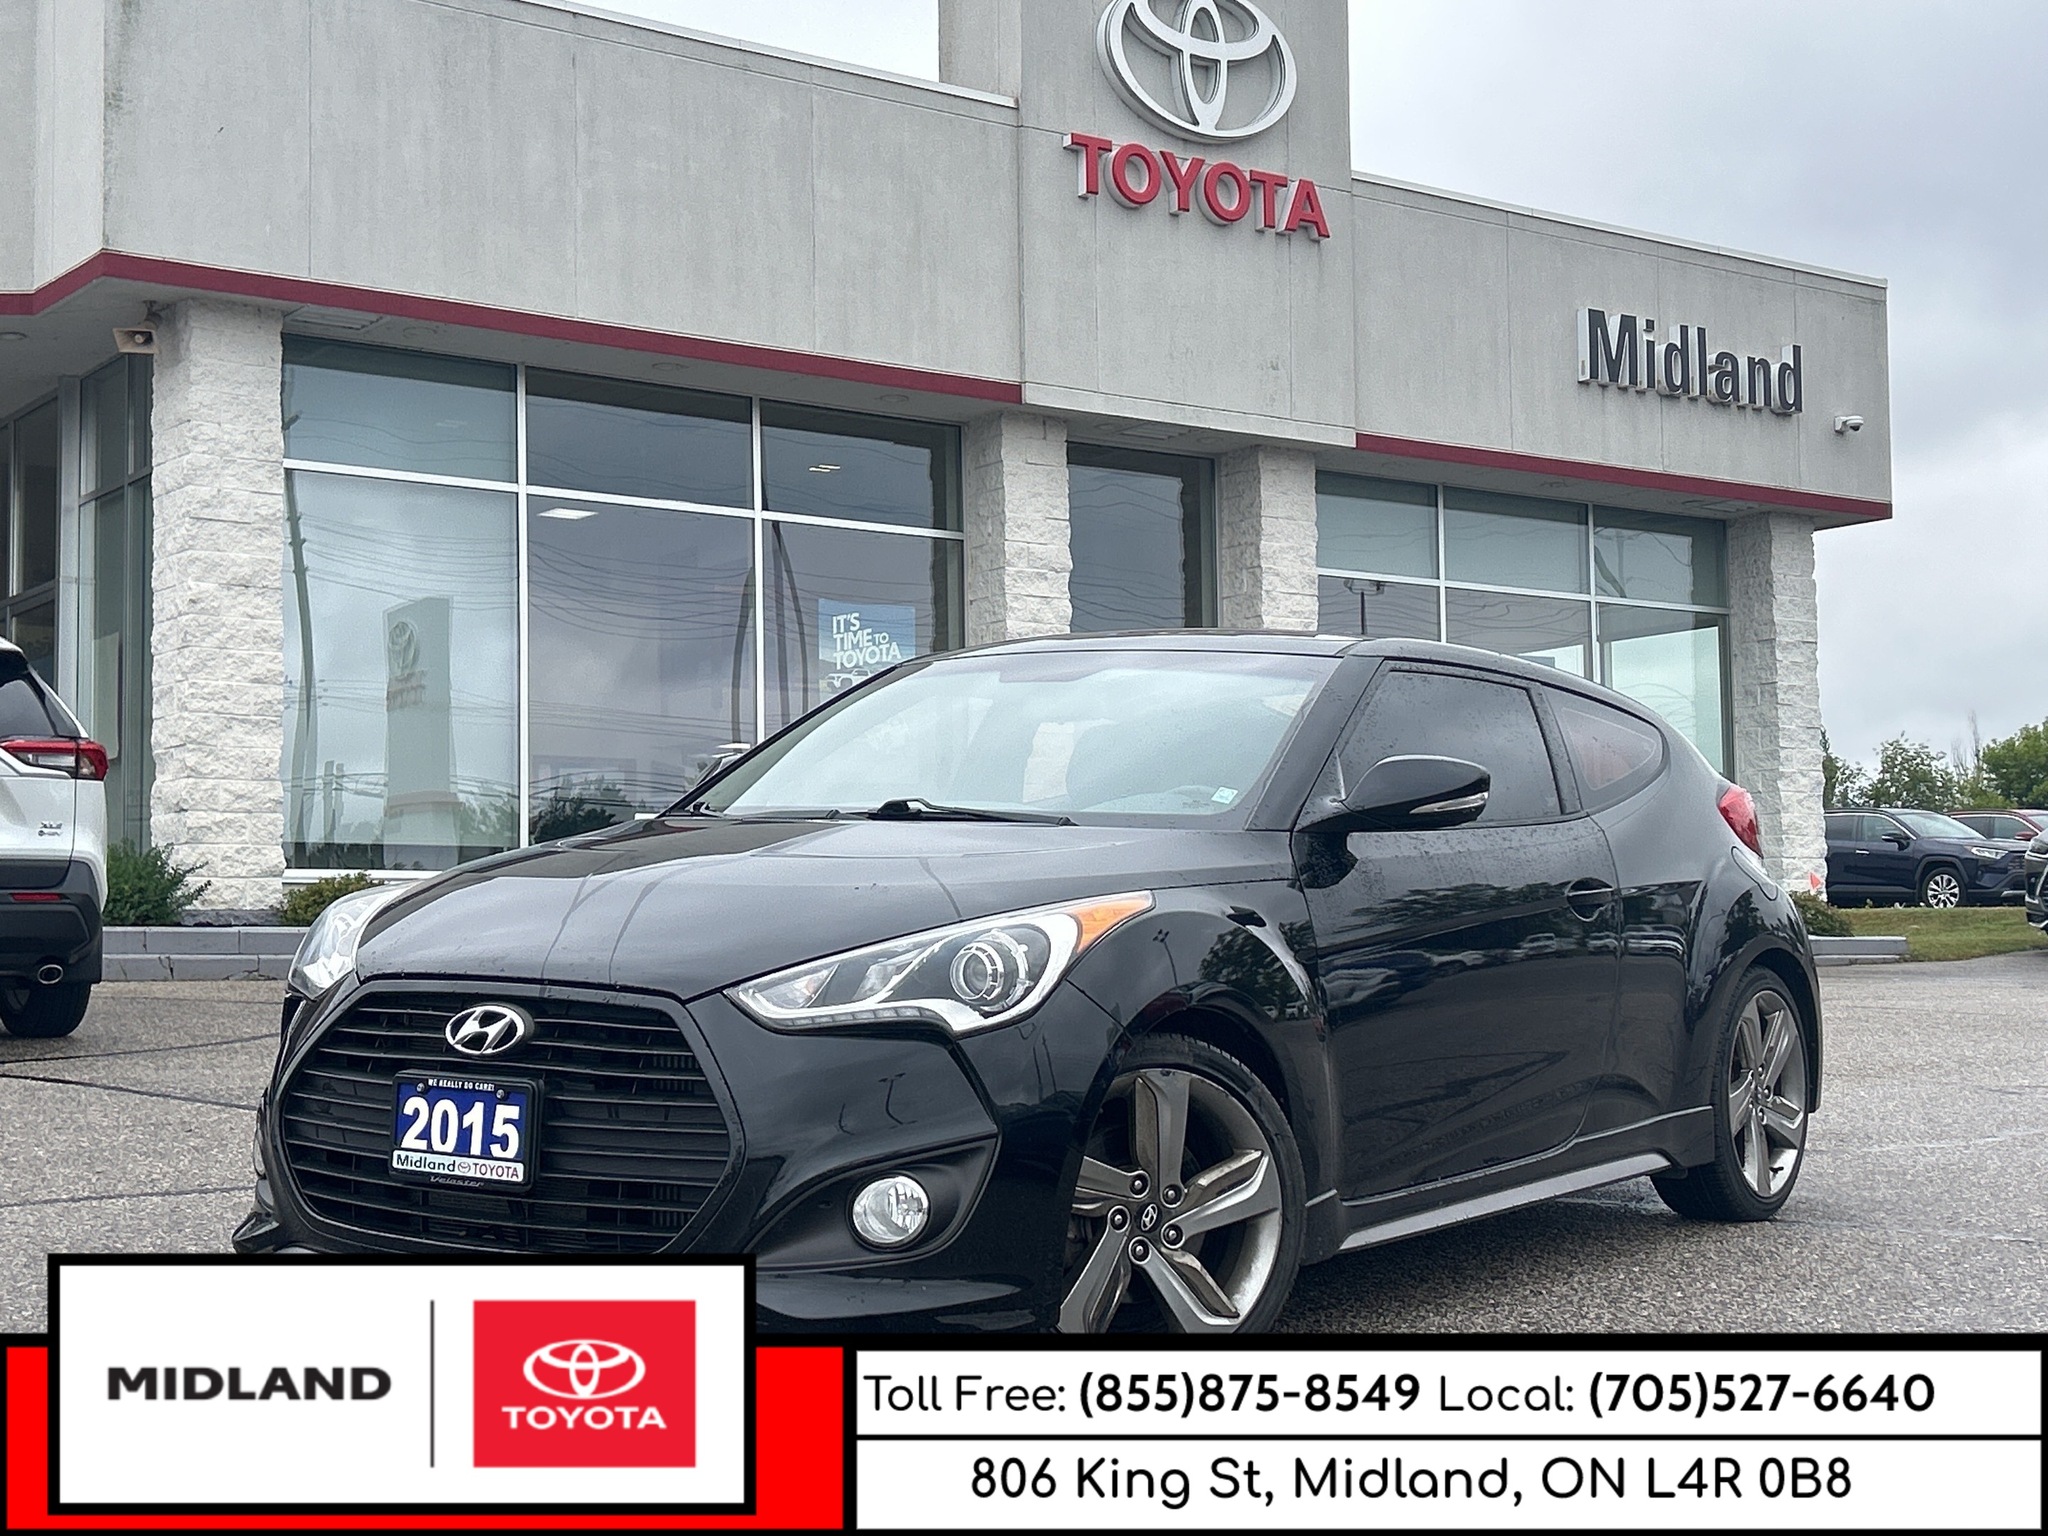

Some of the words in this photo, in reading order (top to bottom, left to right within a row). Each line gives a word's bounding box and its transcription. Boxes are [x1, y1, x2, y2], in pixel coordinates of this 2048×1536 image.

[1064, 132, 1331, 241] TOYOTA
[1578, 308, 1803, 415] Midland
[832, 612, 861, 634] IT'S
[833, 628, 873, 652] TIME
[873, 632, 890, 645] TO
[833, 642, 902, 670] TOYOTA
[428, 1079, 438, 1087] WE
[438, 1079, 463, 1089] REALLY
[401, 1096, 520, 1159] 2015
[396, 1154, 456, 1173] Midland
[472, 1162, 519, 1180] TOYOTA
[430, 1175, 484, 1188] Veloster
